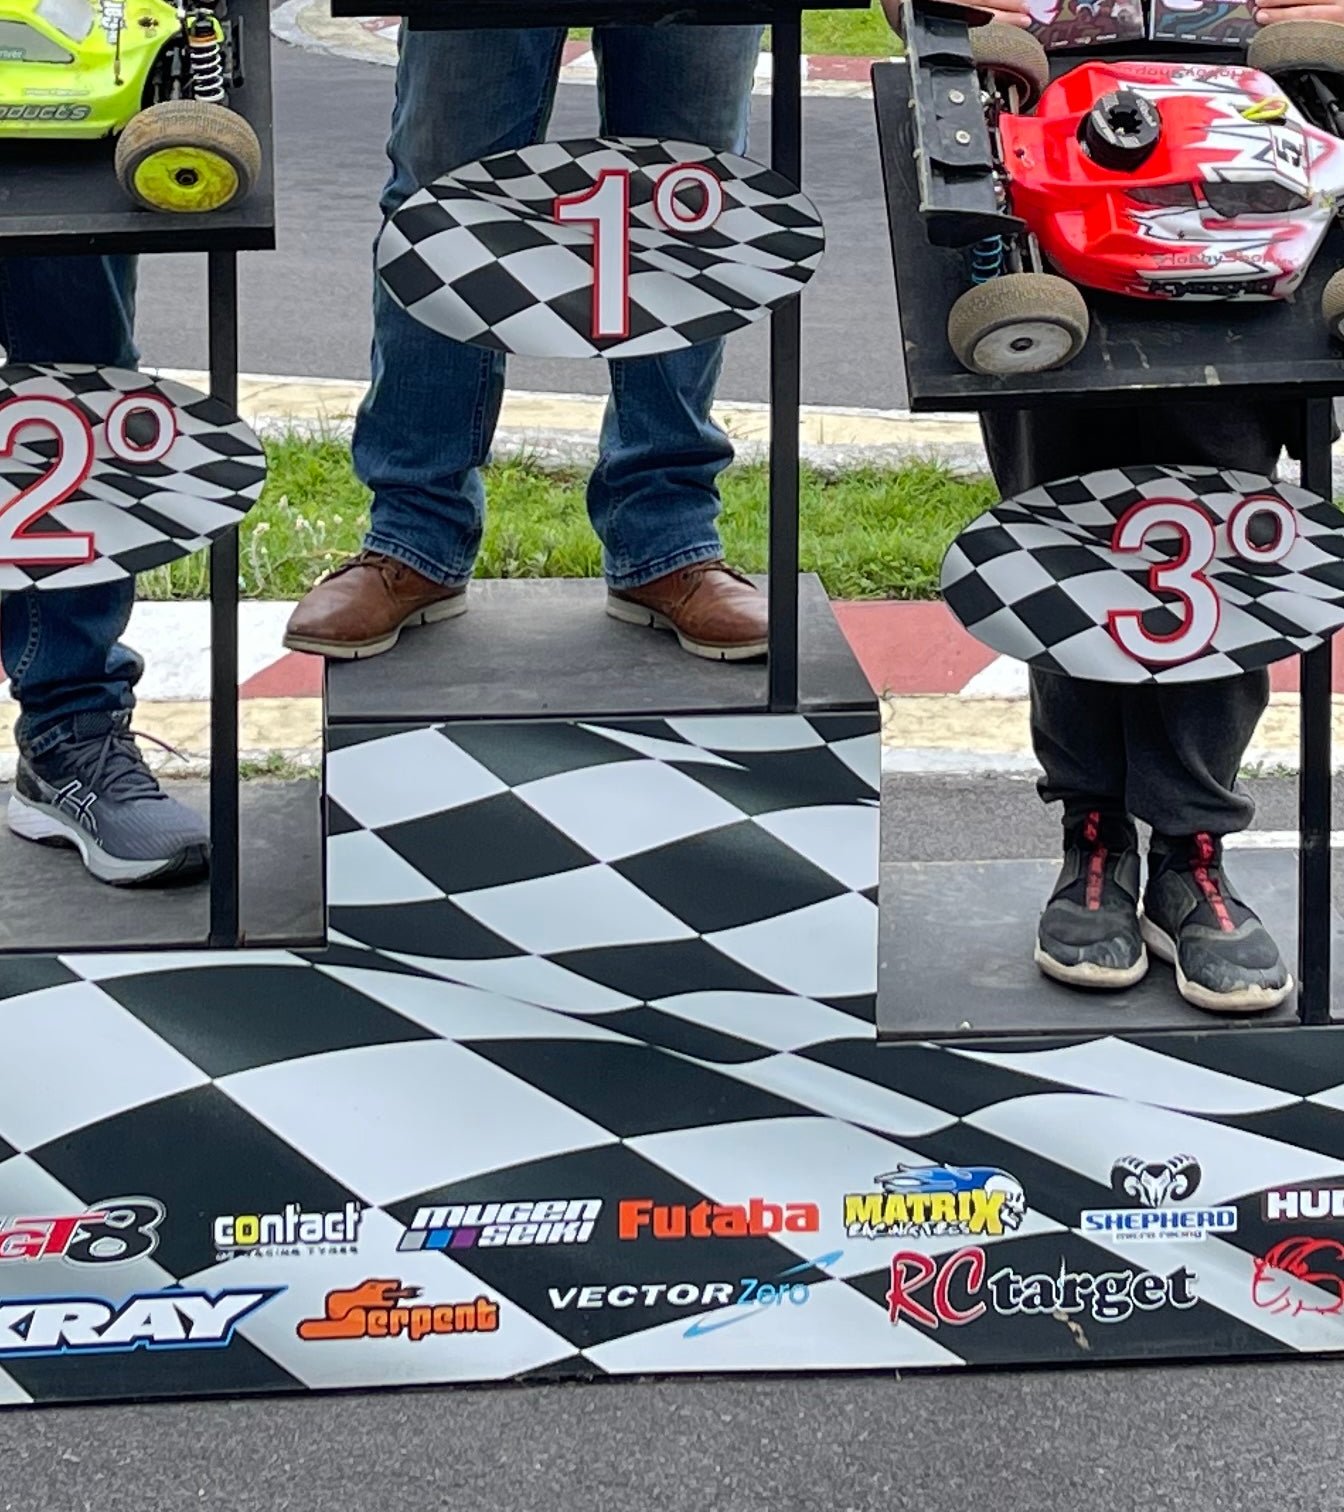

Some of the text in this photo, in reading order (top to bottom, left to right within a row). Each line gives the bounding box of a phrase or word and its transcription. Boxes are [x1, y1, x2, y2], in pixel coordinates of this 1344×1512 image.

[213, 1201, 360, 1246] contact
[618, 1197, 821, 1240] Futaba
[844, 1189, 1007, 1236] MATRIX
[1085, 1209, 1235, 1231] SHEPHERD
[298, 1279, 500, 1341] Serpent
[548, 1279, 810, 1310] VECTOR Zero
